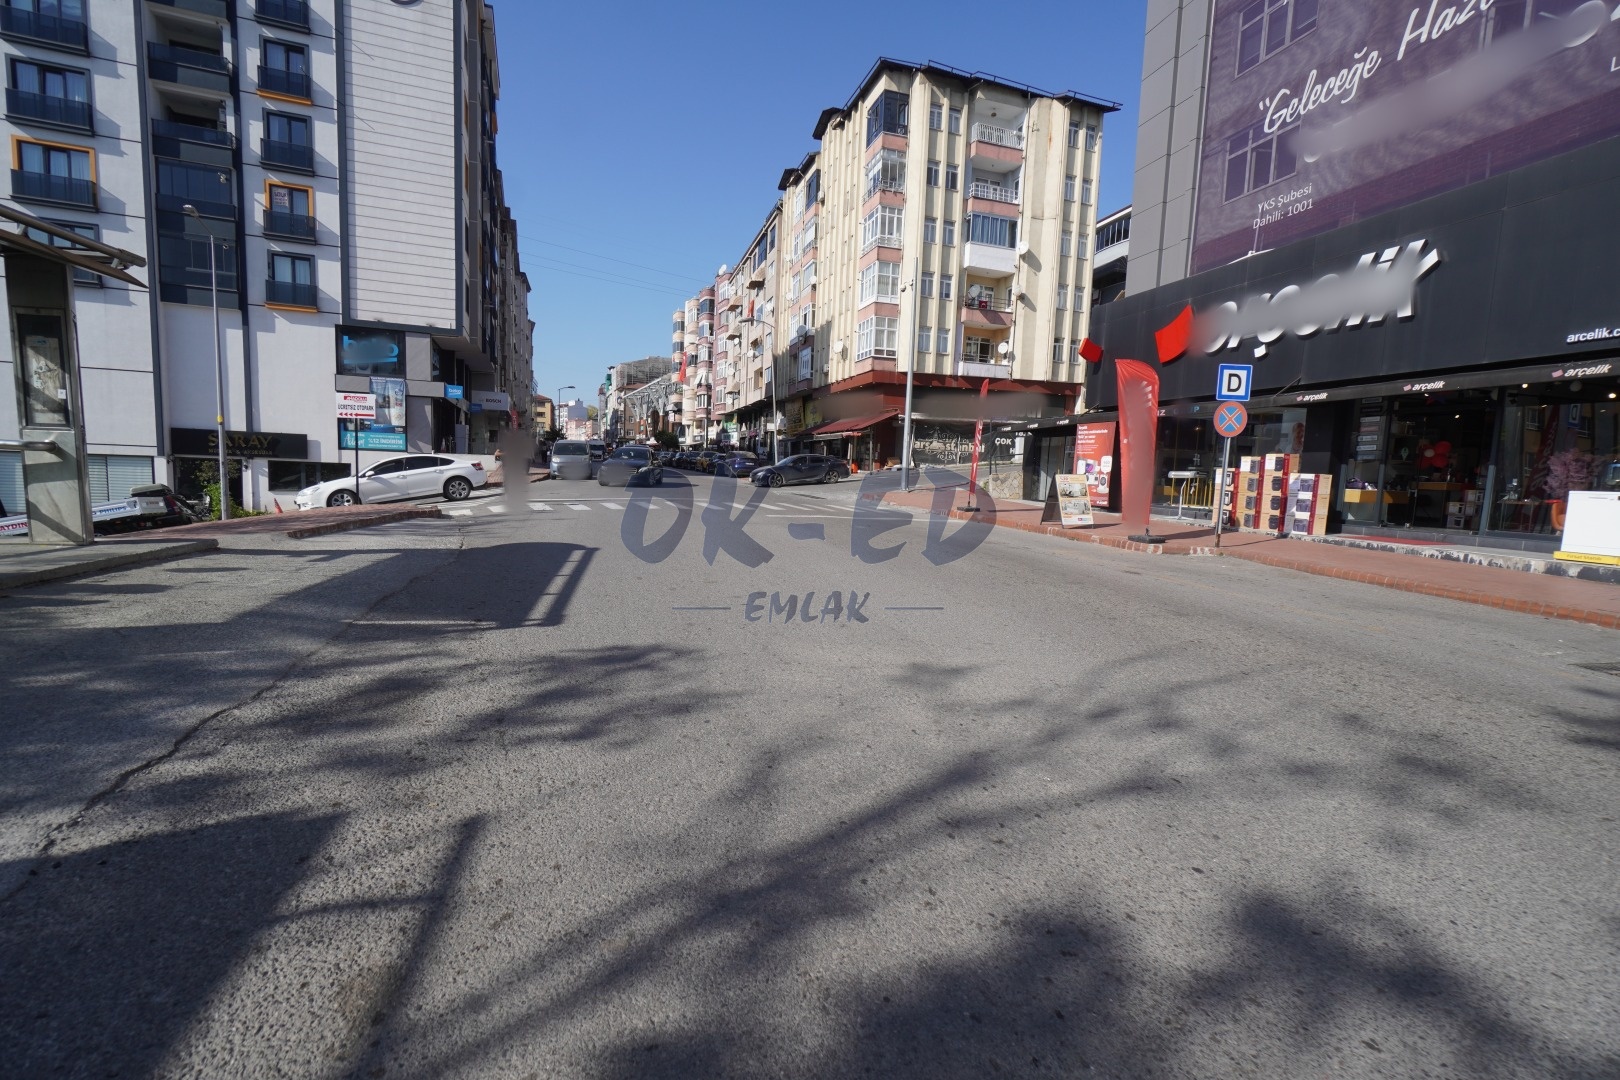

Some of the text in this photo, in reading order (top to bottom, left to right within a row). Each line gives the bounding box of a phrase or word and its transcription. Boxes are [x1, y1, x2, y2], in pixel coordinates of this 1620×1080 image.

[1258, 182, 1313, 213] YKS Şubesi
[1252, 198, 1313, 229] Dahili: 1001
[1564, 363, 1612, 378] arçelik
[1227, 373, 1242, 392] D
[1412, 380, 1446, 392] arçelik
